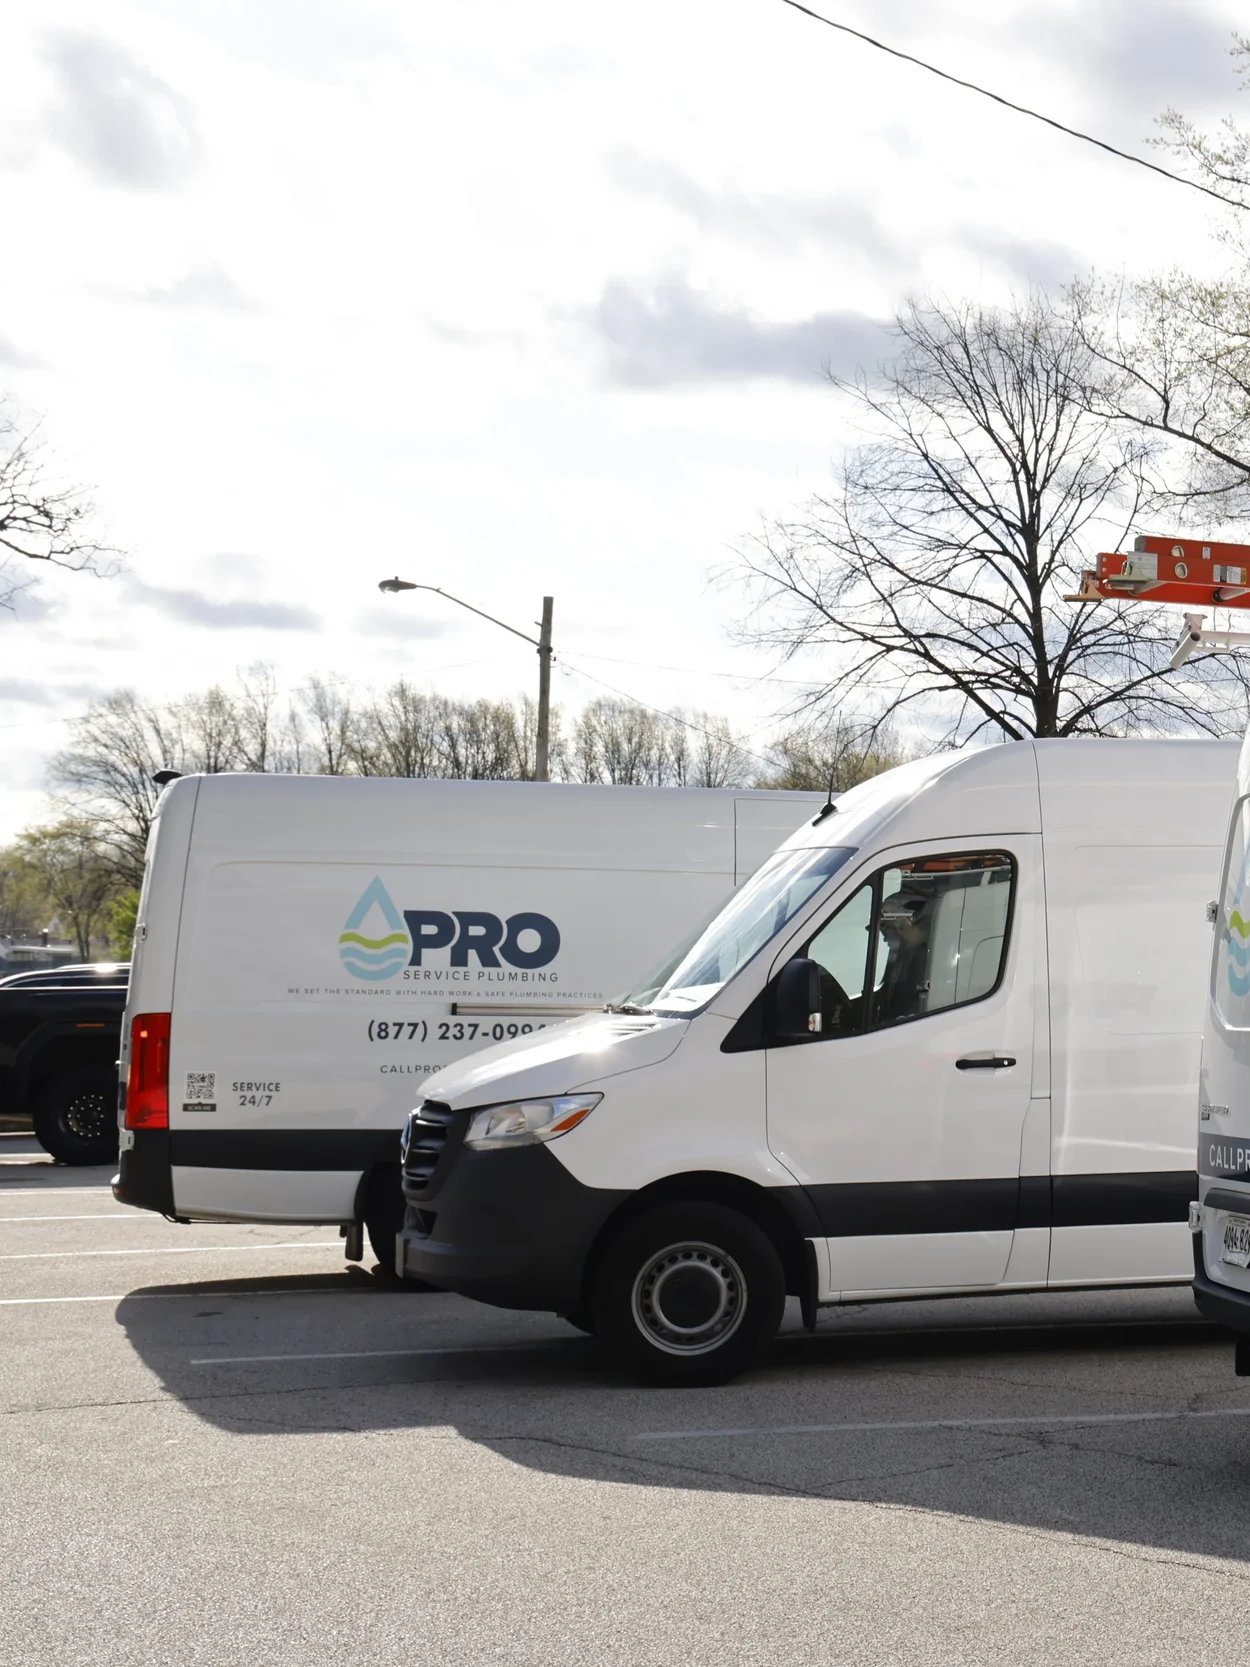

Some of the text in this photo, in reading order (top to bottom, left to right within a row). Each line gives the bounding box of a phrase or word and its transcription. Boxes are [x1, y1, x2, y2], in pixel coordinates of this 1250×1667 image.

[404, 910, 561, 969] PRO
[403, 970, 559, 982] SERVICE PLUMBING
[344, 988, 392, 996] STANDARD
[367, 1019, 428, 1042] (877)
[380, 1064, 447, 1074] CALLPRO
[232, 1082, 281, 1092] SERVICE
[239, 1095, 273, 1107] 24/7
